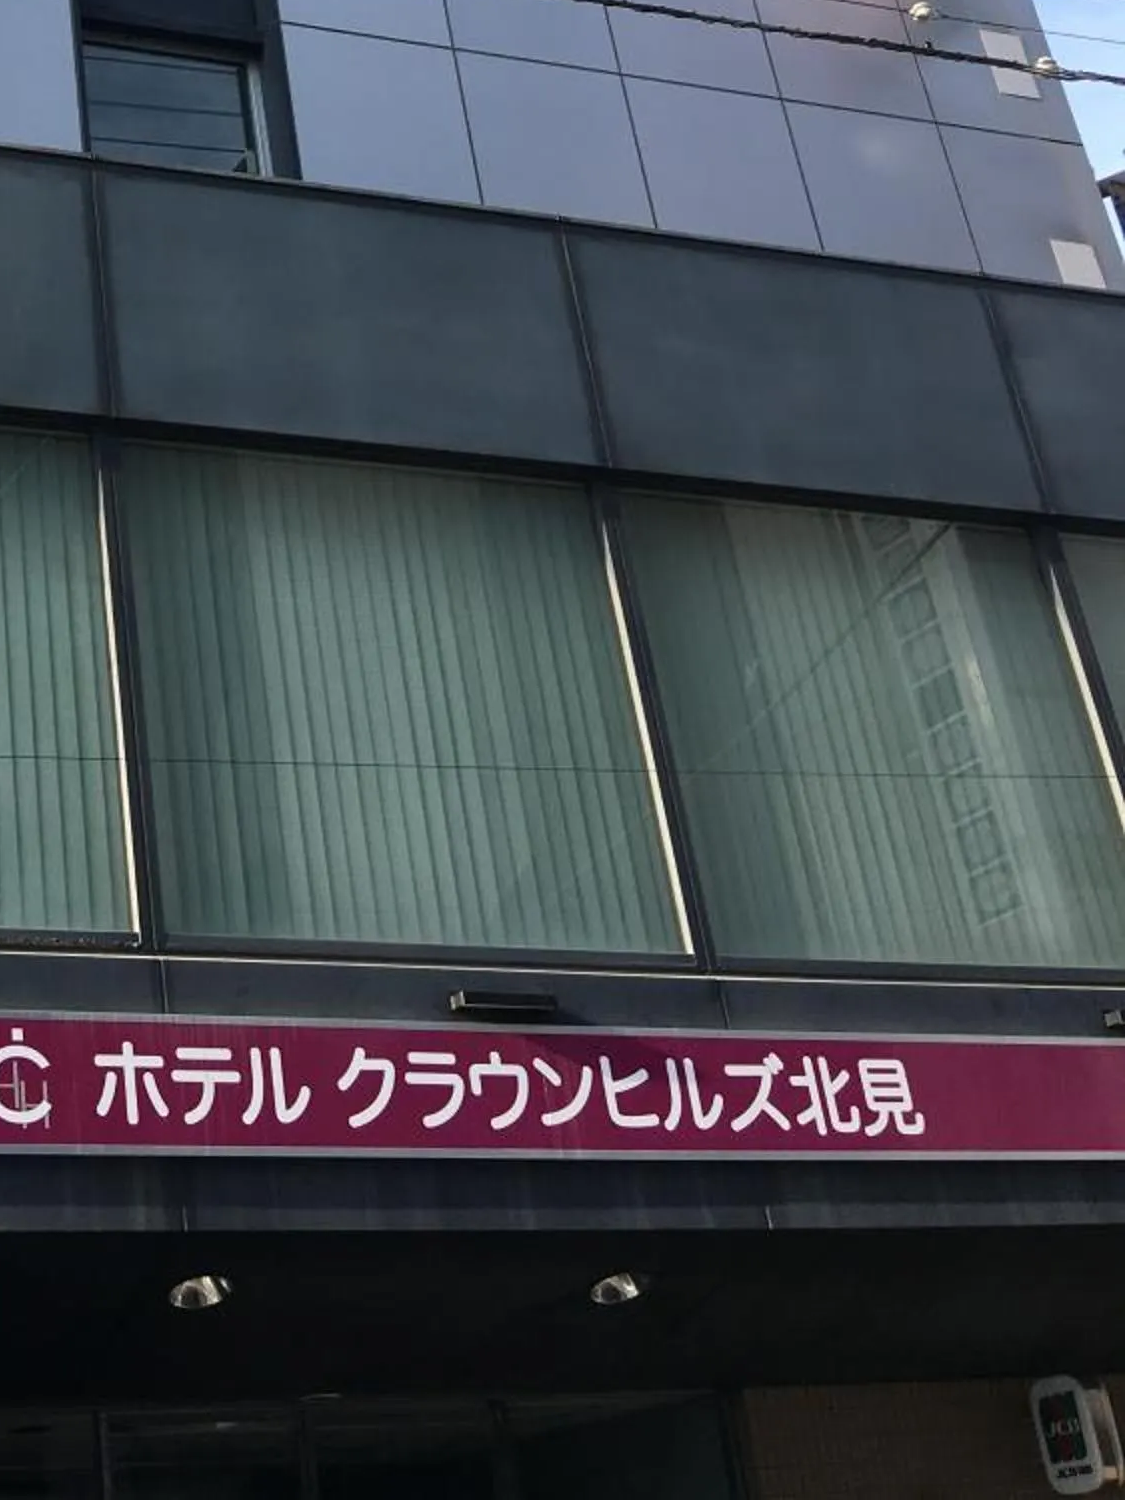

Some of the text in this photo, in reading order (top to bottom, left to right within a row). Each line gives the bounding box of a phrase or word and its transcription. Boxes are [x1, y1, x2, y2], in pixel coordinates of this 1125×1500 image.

[94, 1041, 925, 1137] ホテル クラウンヒルズ北見
